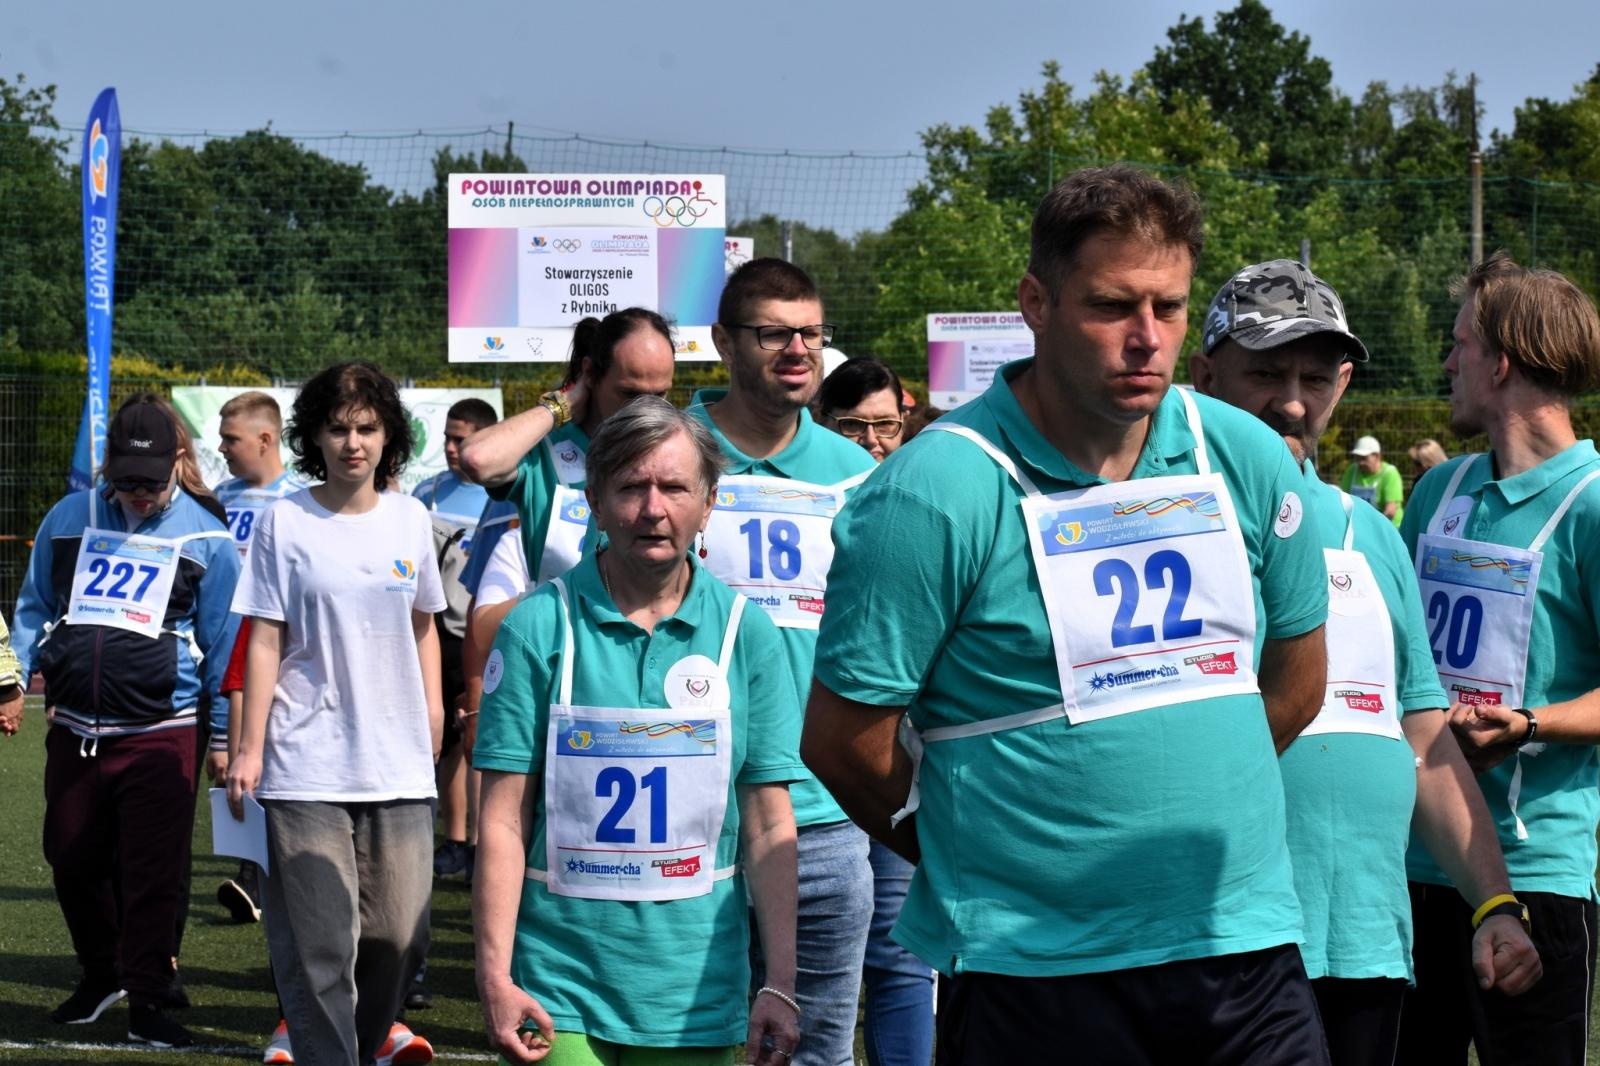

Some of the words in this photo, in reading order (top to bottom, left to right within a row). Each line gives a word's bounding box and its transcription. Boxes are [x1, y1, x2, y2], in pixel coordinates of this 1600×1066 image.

[461, 179, 581, 196] POWIATOWA
[586, 180, 692, 196] OLIMPIADA
[472, 196, 505, 208] OSÓB
[509, 197, 635, 208] NIEPEŁNOSPRAWNYCH
[92, 215, 110, 315] POWIAT
[545, 266, 633, 282] Stowarzyszenie
[569, 283, 609, 296] OLIGOS
[561, 303, 567, 313] z
[571, 300, 617, 316] Rybnika
[935, 316, 997, 325] POWIATOWA
[1086, 517, 1114, 527] POWIAT
[740, 518, 801, 581] 18
[83, 558, 159, 603] 227
[1093, 549, 1203, 649] 22
[1428, 591, 1483, 669] 20
[1185, 653, 1215, 664] STUDIO
[1106, 664, 1179, 688] Summer-cha
[1461, 693, 1496, 707] EFEKT
[595, 766, 667, 844] 21
[579, 860, 641, 875] Summer-cha
